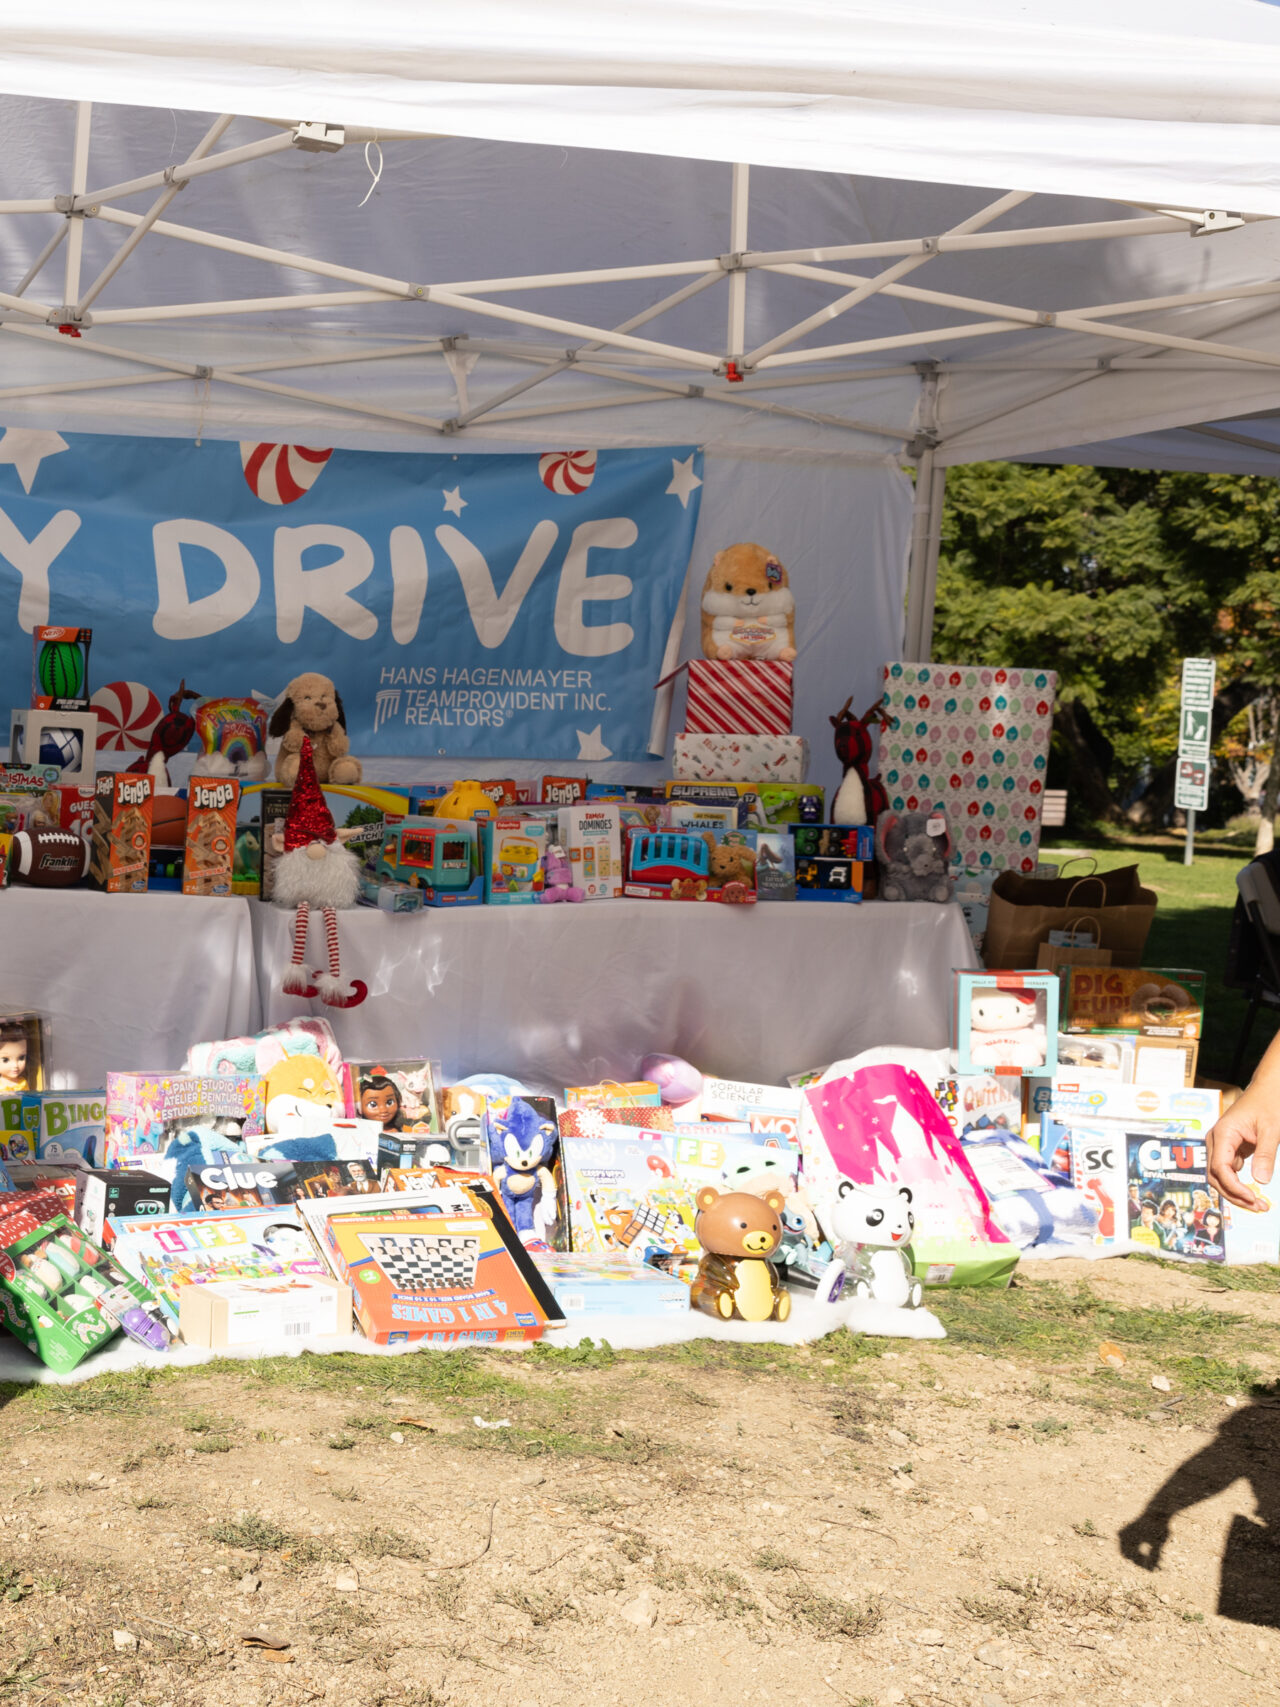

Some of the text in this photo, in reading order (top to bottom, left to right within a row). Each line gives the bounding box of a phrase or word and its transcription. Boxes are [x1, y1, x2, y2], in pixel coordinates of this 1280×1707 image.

[152, 517, 638, 656] DRIVE
[380, 667, 592, 688] HANS HAGENMAYER
[405, 690, 612, 711] TEAMPROVIDENT INC.
[117, 778, 150, 804] Jenga
[193, 783, 234, 810] Jenga
[545, 782, 581, 803] Jenga
[671, 786, 738, 797] SUPREME
[70, 800, 95, 813] GUES
[81, 810, 91, 819] IN
[579, 819, 613, 830] DOMINOES
[1074, 974, 1123, 995] DIG
[1092, 996, 1130, 1014] UP!
[173, 1079, 234, 1093] PAINT STUDIO
[710, 1081, 764, 1095] POPULAR
[164, 1091, 243, 1106] ATELIER PEINTURE
[712, 1091, 761, 1104] SCIENCE
[44, 1101, 106, 1136] BING
[162, 1104, 198, 1120] ESTUDIO
[210, 1103, 246, 1118] PINTURA
[50, 1145, 58, 1153] 75
[567, 1142, 616, 1166] Bluey
[1139, 1140, 1207, 1171] CLUE
[200, 1166, 278, 1190] Clue
[159, 1224, 241, 1250] LIFE
[391, 1303, 455, 1323] GAMES
[458, 1306, 470, 1322] 1
[472, 1302, 496, 1321] IN
[493, 1299, 508, 1315] 4
